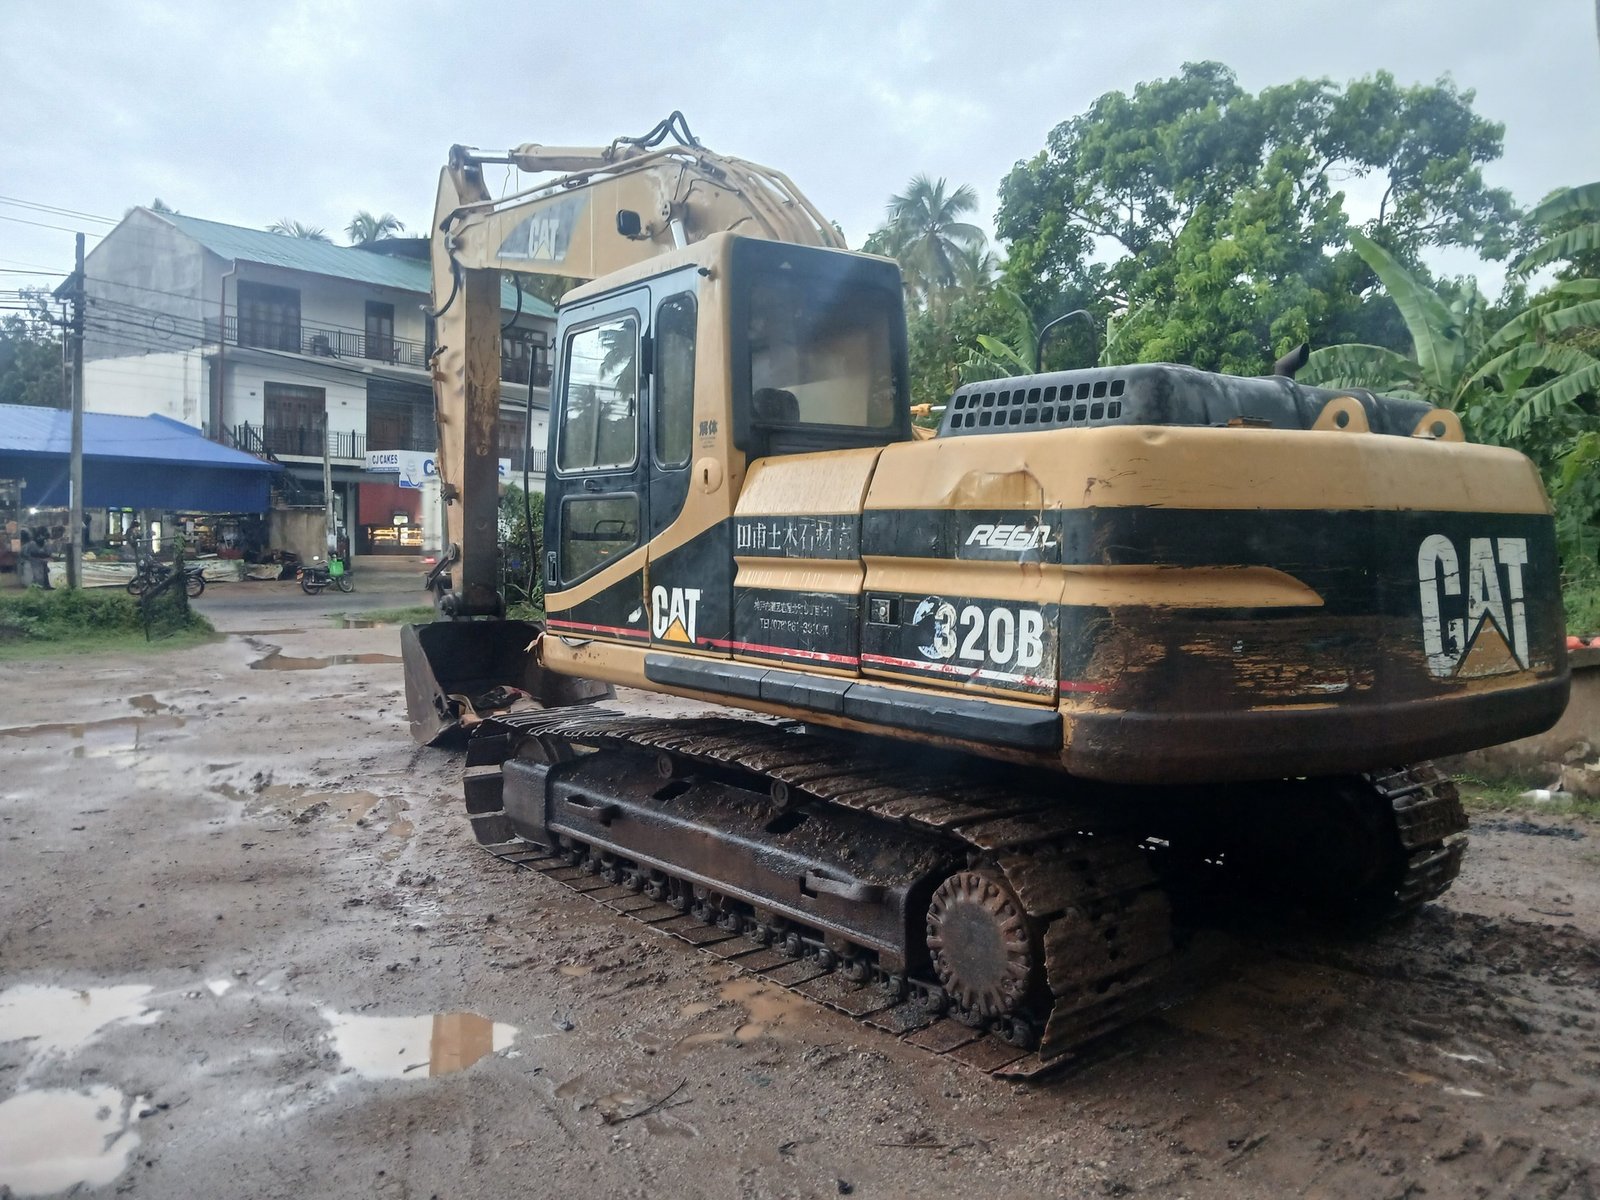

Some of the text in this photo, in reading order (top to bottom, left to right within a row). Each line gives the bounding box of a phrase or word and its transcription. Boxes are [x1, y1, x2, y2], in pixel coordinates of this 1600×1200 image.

[528, 214, 560, 260] CAT
[372, 454, 398, 465] CJ CAKES
[652, 585, 701, 644] CAT
[934, 602, 1045, 668] 320B
[1418, 533, 1530, 678] CAT
